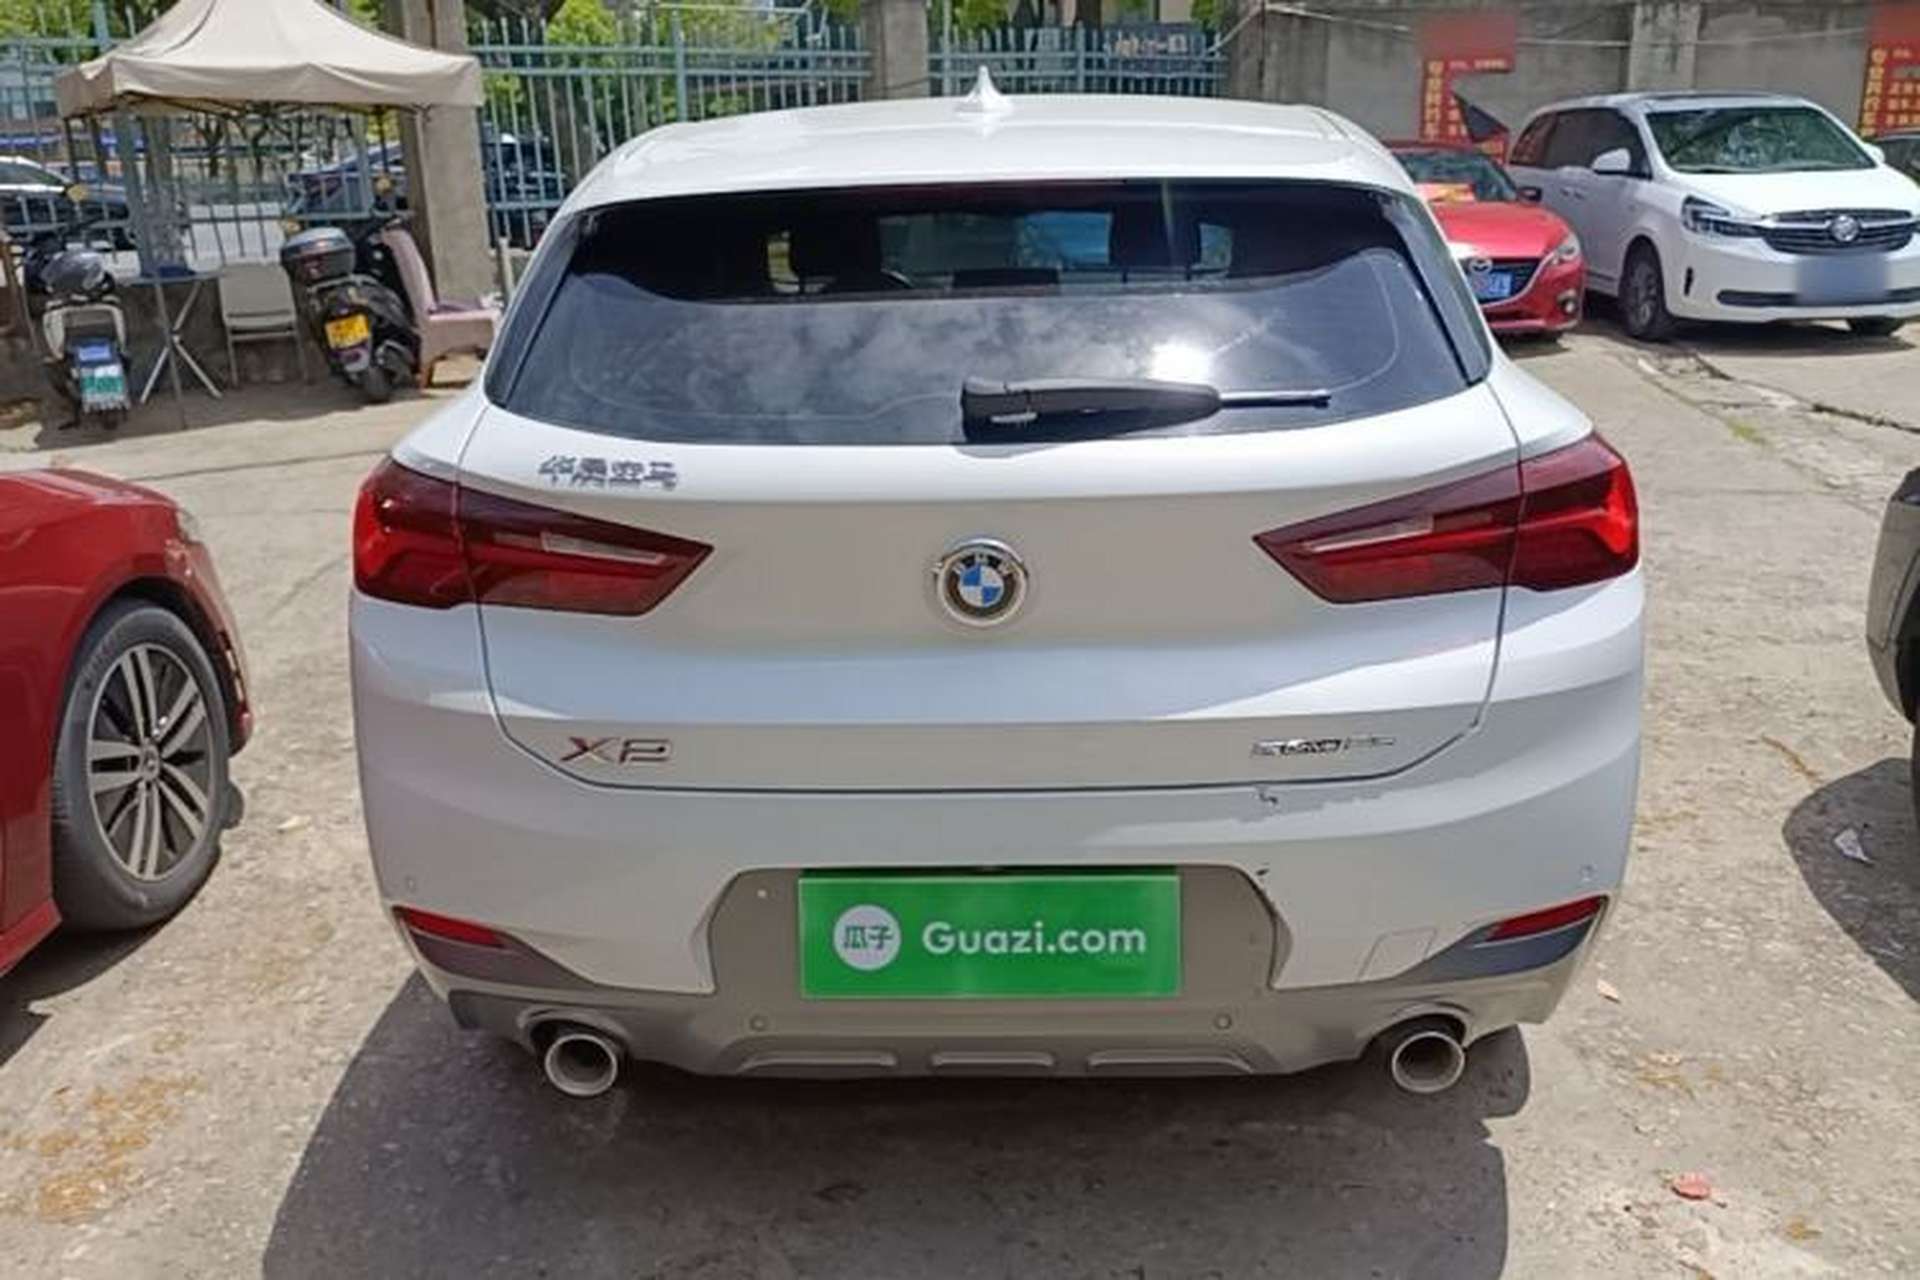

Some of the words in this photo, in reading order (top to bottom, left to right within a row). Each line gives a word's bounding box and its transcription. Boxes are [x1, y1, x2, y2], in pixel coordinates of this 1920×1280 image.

[560, 735, 669, 765] X2
[843, 925, 893, 951] 瓜子
[922, 921, 1147, 955] Guazi.com
